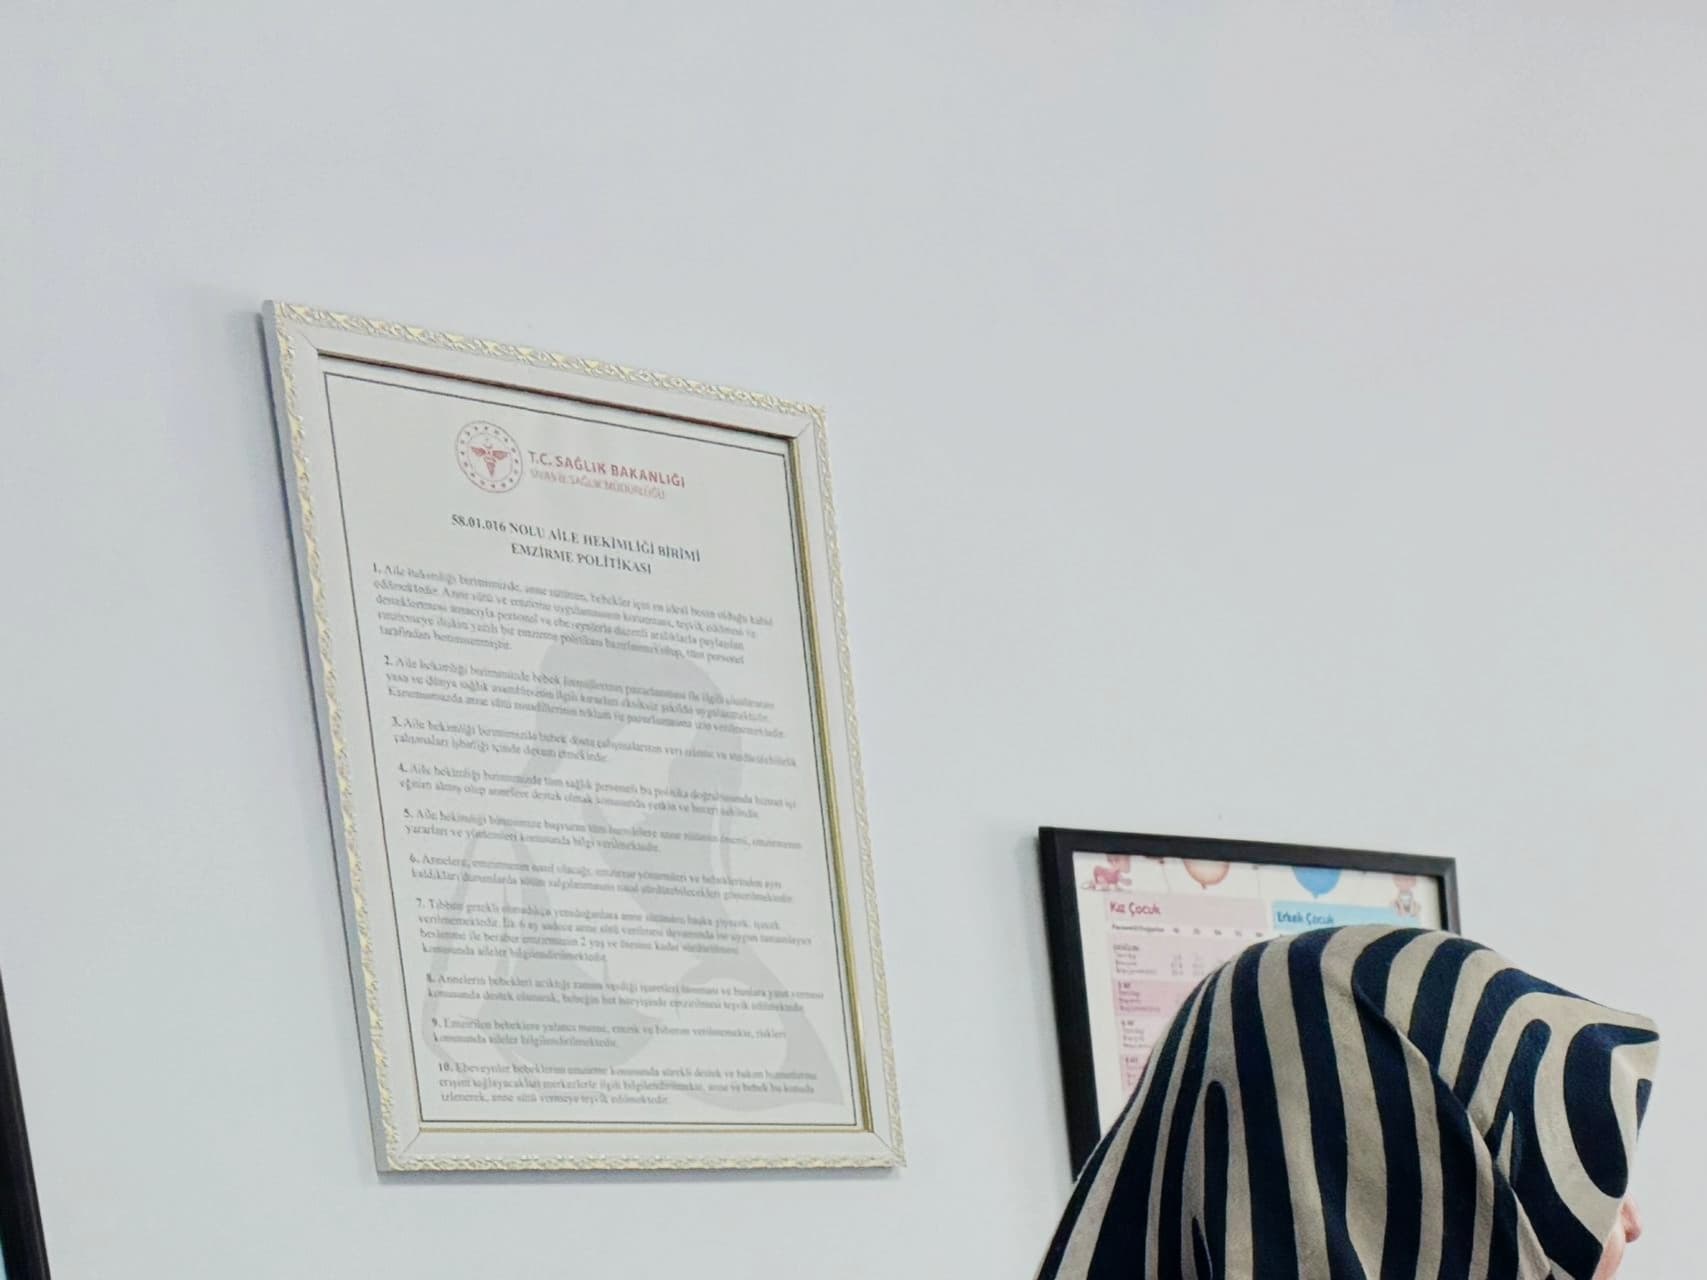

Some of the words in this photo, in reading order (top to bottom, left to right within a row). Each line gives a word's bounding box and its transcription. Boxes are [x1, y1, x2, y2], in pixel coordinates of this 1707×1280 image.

[555, 454, 606, 474] SAĞLIK
[611, 464, 686, 489] BAKANLIĞI
[508, 521, 544, 540] NOLU
[549, 526, 580, 545] AİLE
[583, 532, 655, 556] HEKİMLİĞİ
[658, 543, 701, 563] BİRİMİ
[511, 542, 575, 564] EMZİRME
[577, 553, 652, 575] POLİTİKASI
